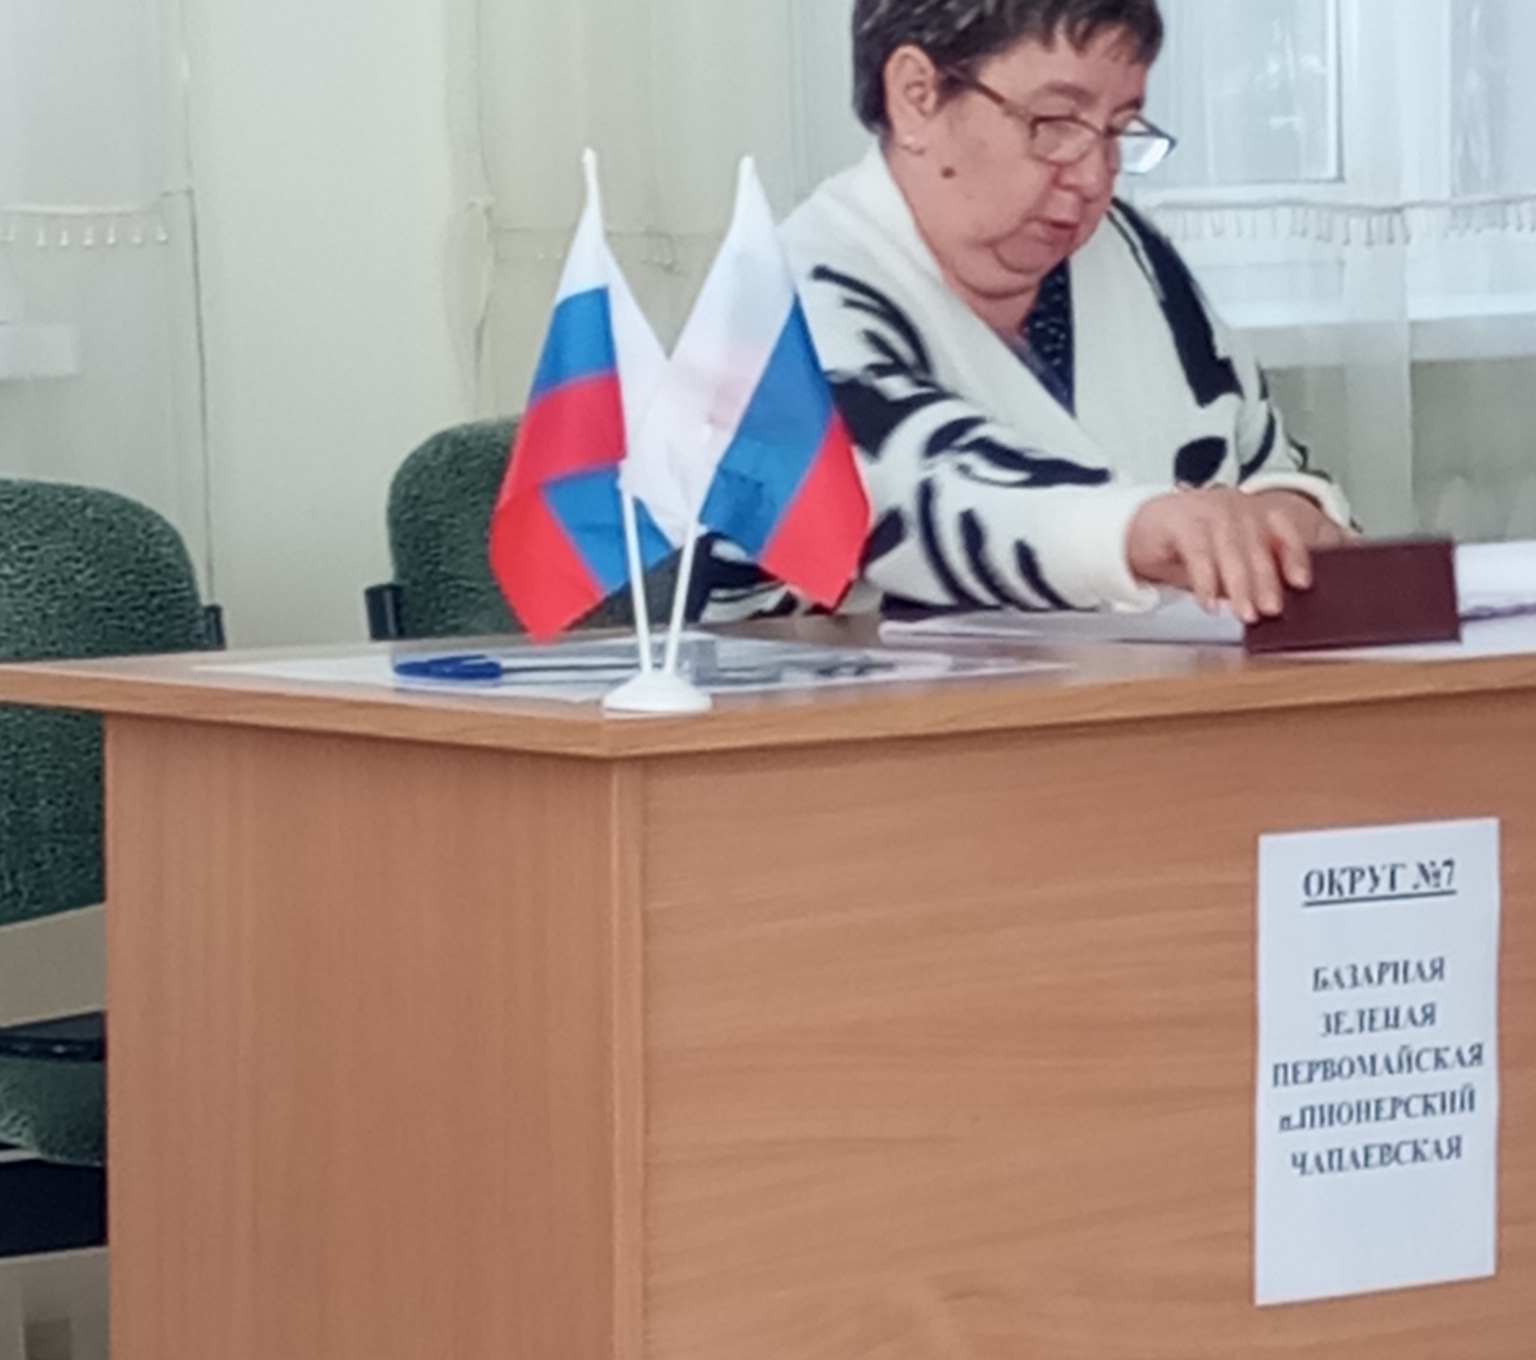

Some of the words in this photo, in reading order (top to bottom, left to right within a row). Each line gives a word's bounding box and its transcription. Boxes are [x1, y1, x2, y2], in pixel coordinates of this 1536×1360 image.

[1303, 862, 1407, 898] ОКРУГ
[1412, 857, 1455, 891] №7
[1312, 956, 1445, 992] БАЗАРНАЯ
[1272, 1042, 1484, 1088] ПЕРВОМАЙСКАЯ
[1279, 1082, 1476, 1133] п.ПИОНЕРСКИЙ
[1290, 1134, 1463, 1177] ЧАПАЕВСКАЯ
